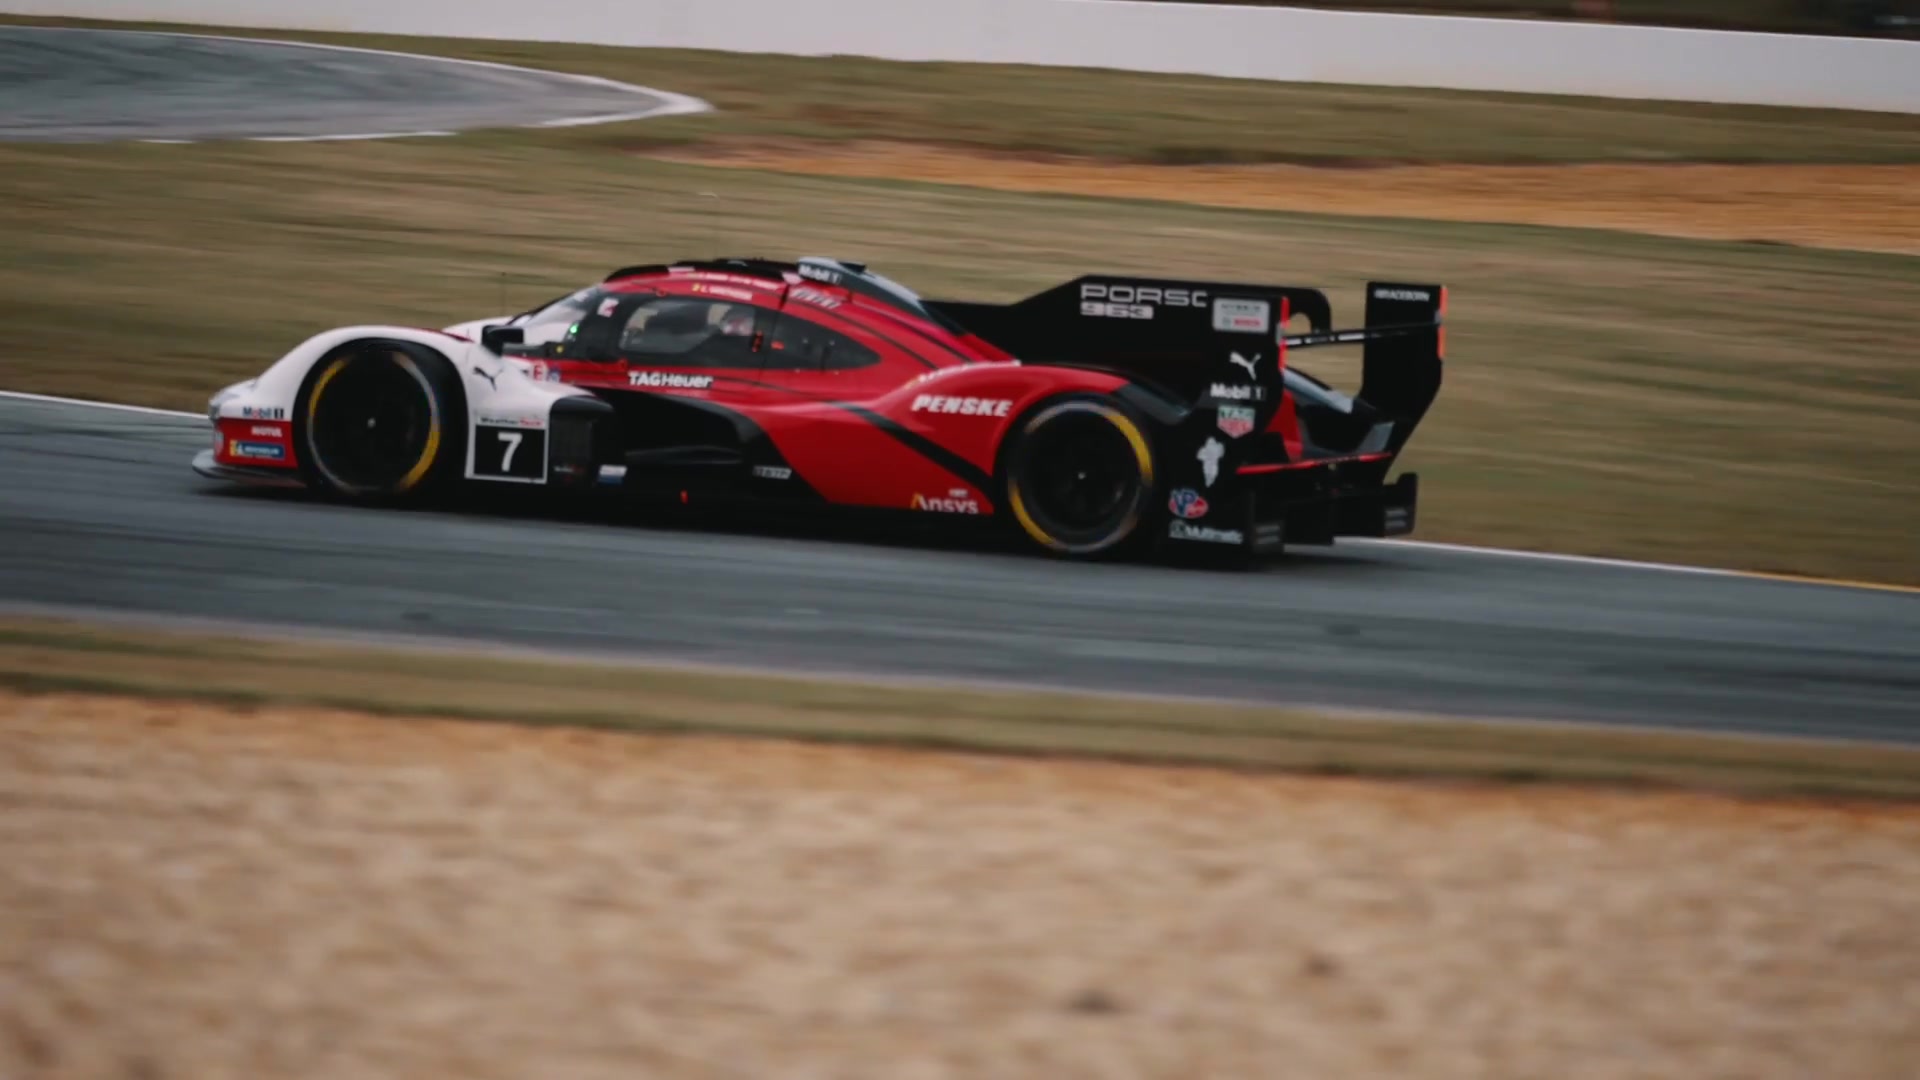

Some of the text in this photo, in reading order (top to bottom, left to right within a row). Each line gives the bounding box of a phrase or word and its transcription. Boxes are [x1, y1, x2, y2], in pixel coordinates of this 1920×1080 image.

[801, 263, 831, 280] Mobil
[1081, 301, 1154, 319] 963
[1210, 383, 1251, 399] Mobil
[243, 407, 271, 419] Mobil
[911, 394, 1013, 417] PENSKE
[498, 432, 523, 472] 7
[911, 492, 979, 514] Ansys
